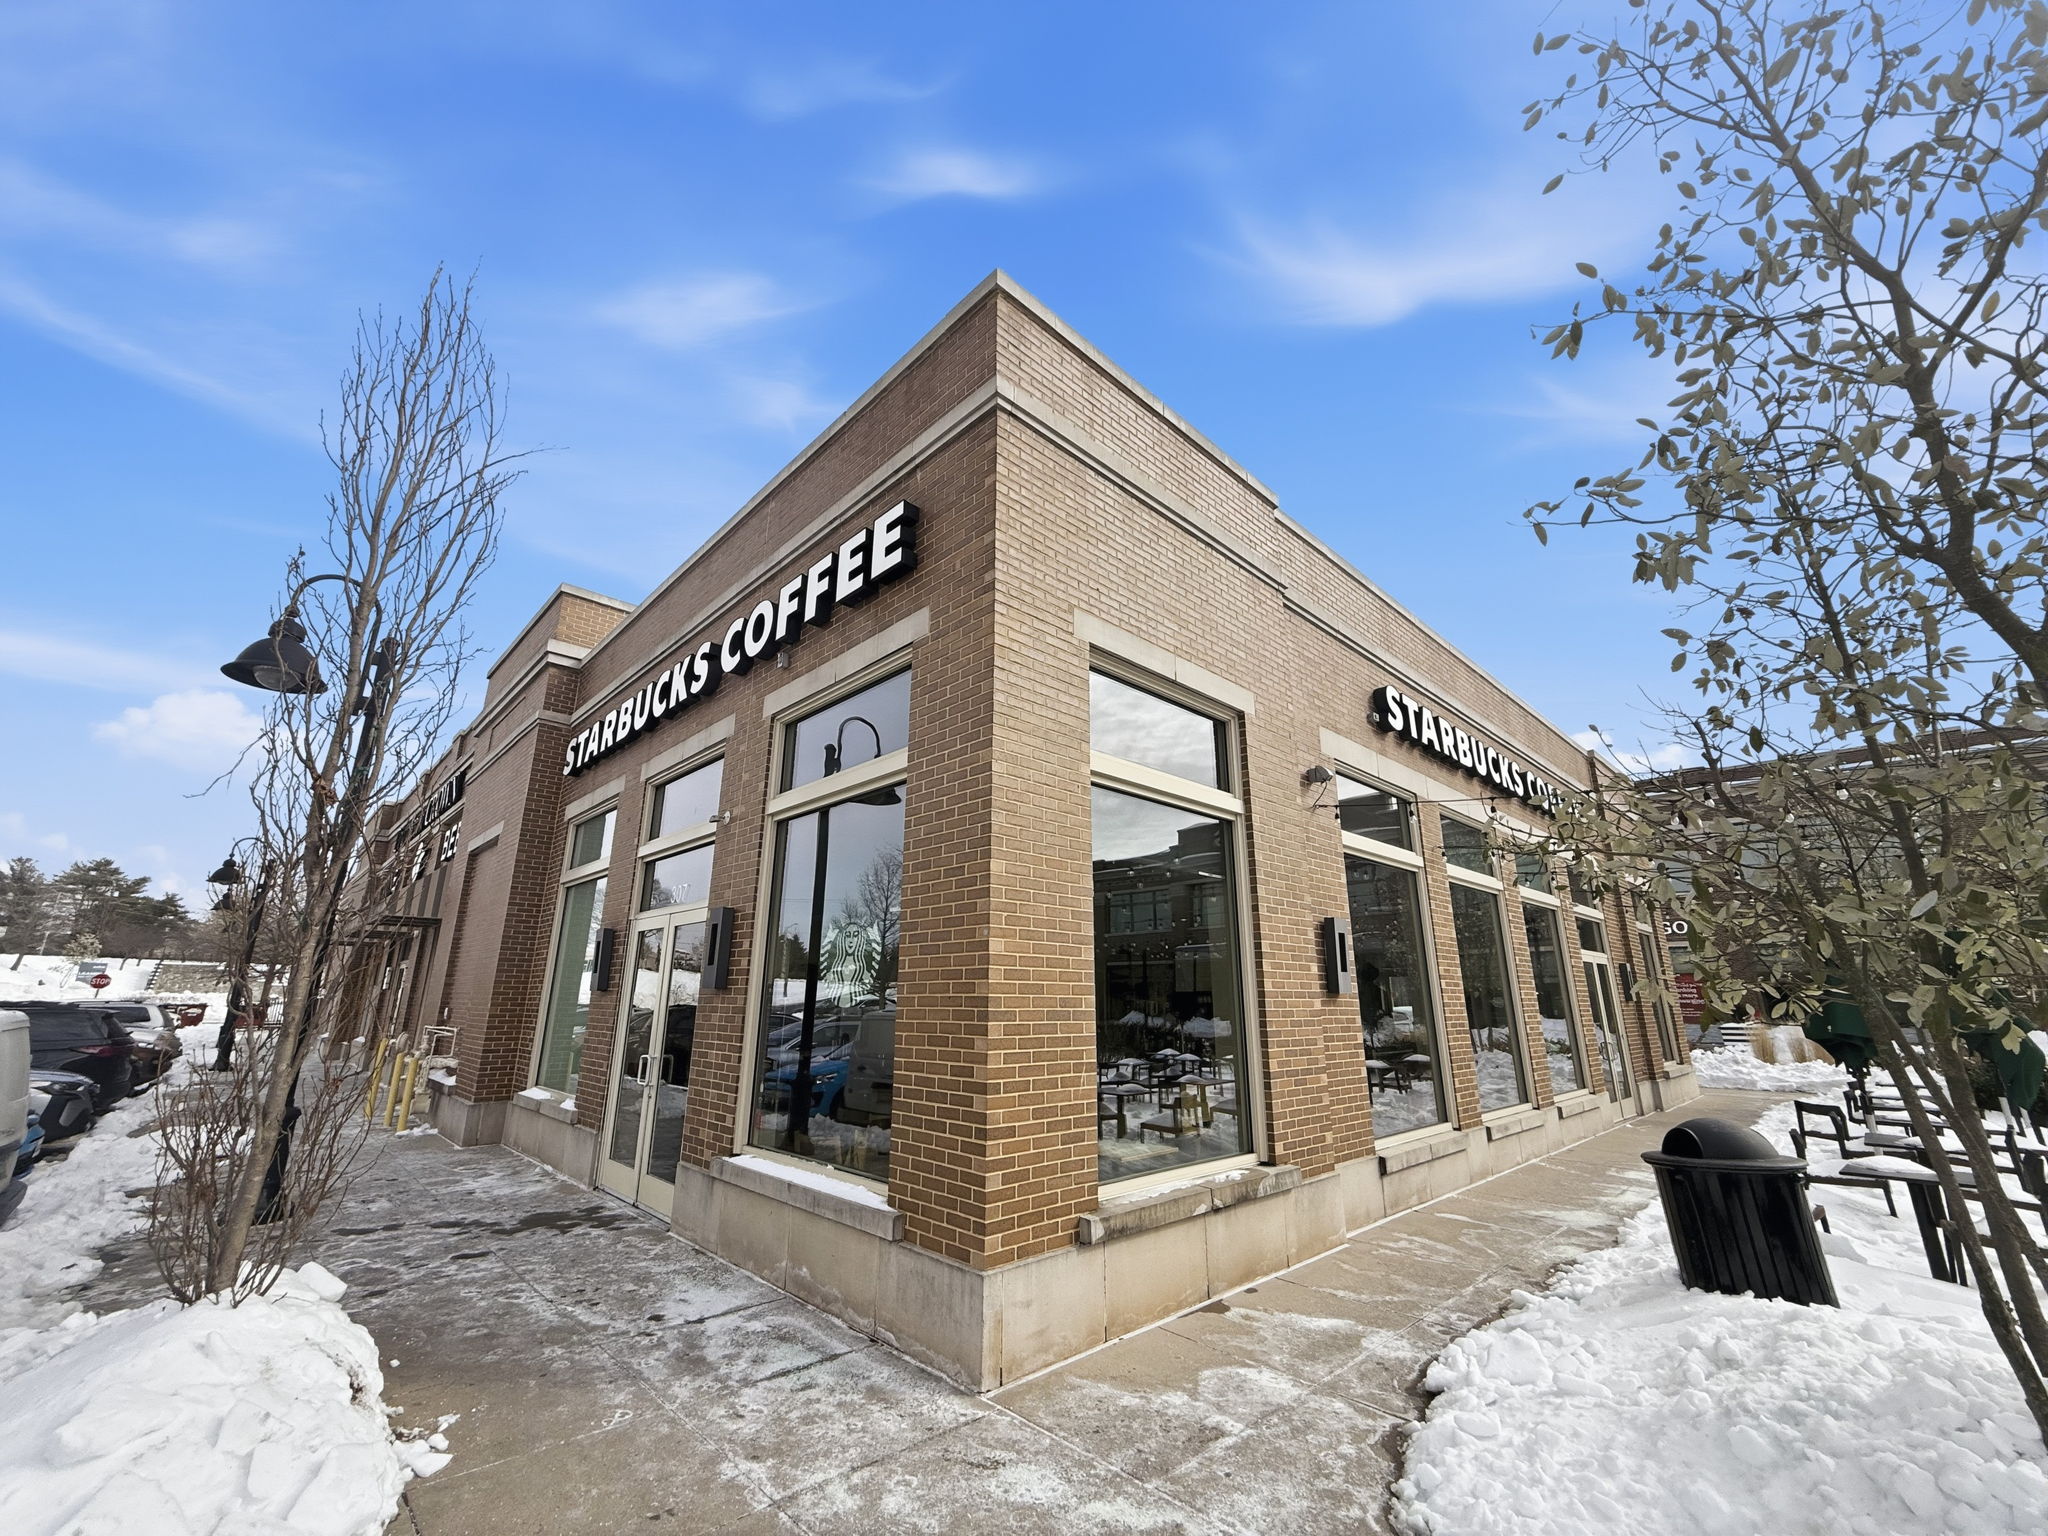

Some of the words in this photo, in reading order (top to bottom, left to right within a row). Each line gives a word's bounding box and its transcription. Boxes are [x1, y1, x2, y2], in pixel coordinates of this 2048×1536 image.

[562, 641, 713, 777] STARBUCKS
[720, 499, 909, 674] COFFEE
[1384, 684, 1525, 798] STARBUCKS
[670, 883, 689, 904] 307
